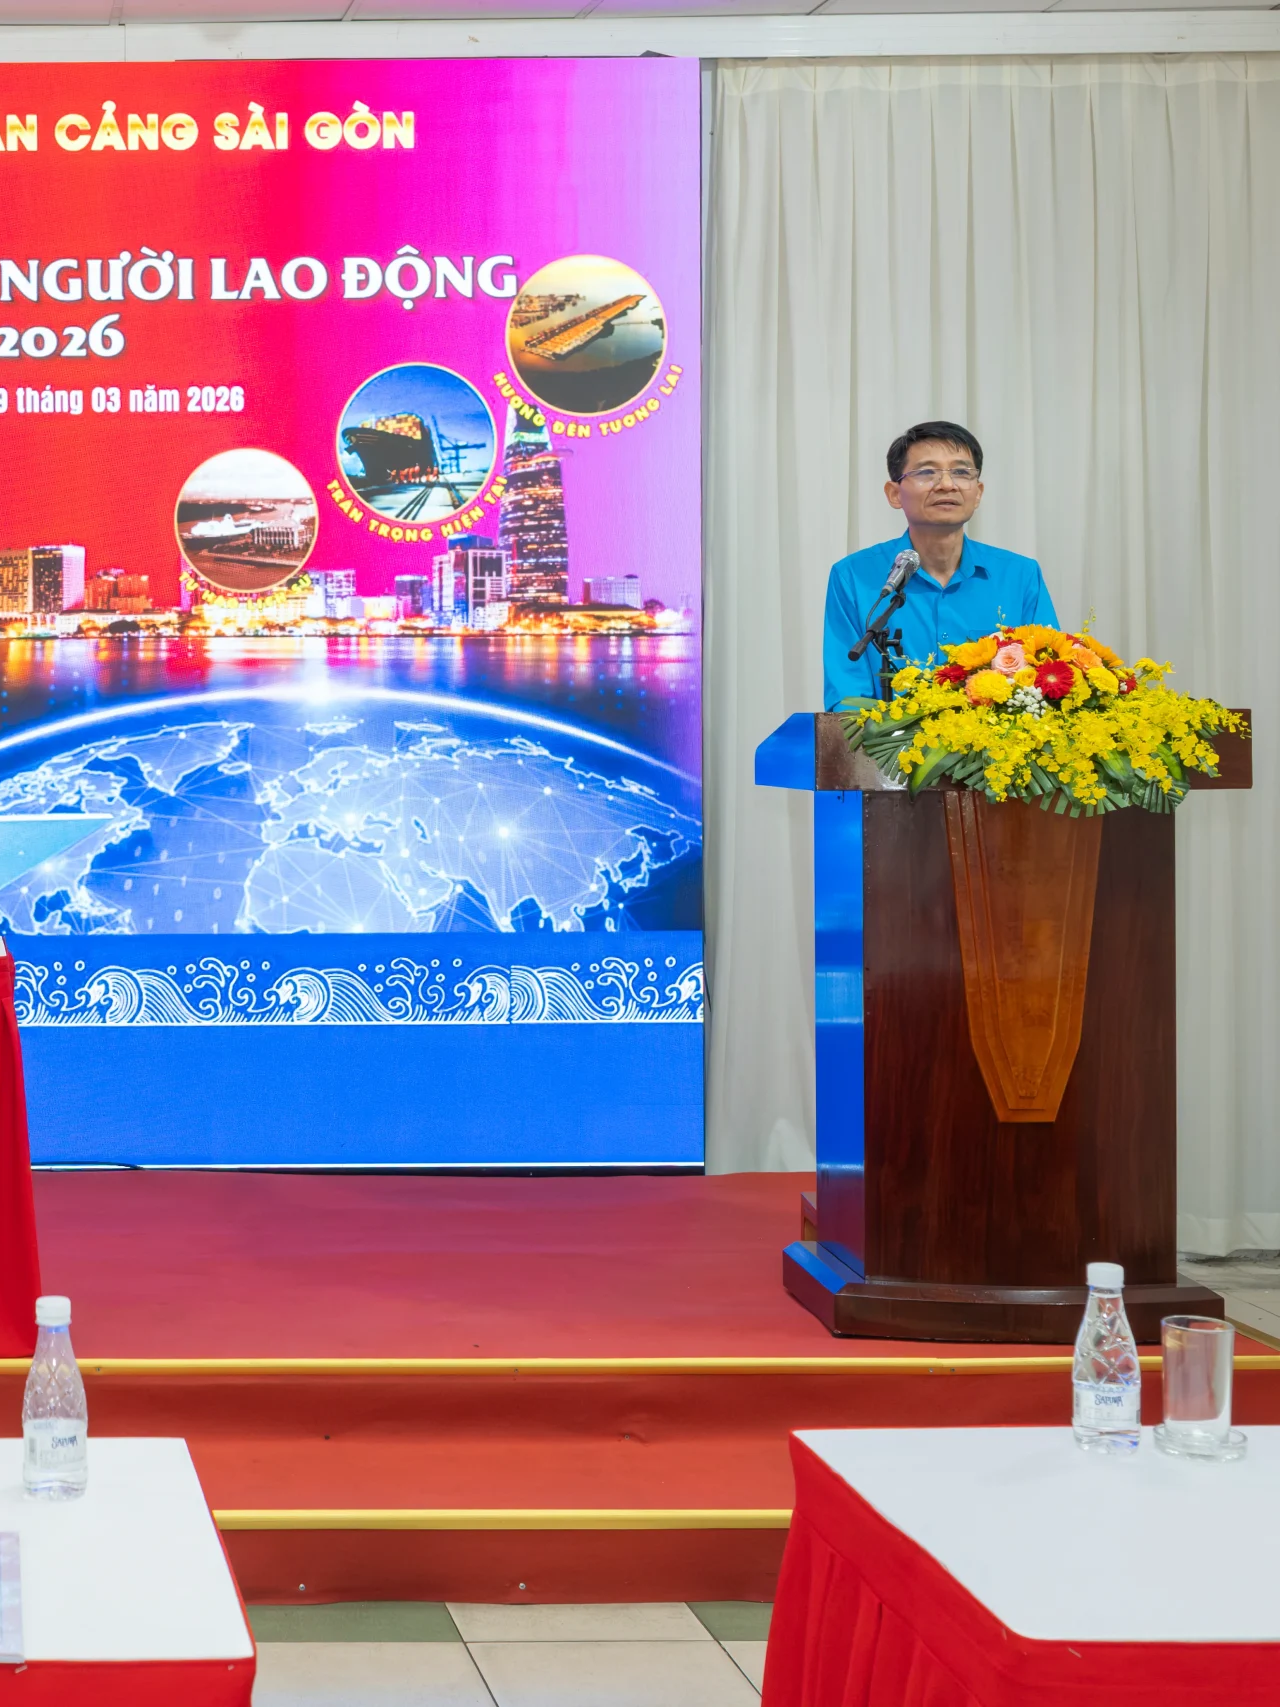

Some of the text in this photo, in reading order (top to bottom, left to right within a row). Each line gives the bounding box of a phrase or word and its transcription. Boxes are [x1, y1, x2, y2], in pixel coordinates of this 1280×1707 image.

[54, 100, 199, 151] CẢNG
[213, 101, 289, 151] SÀI
[304, 100, 416, 151] GÒN
[209, 256, 329, 301] LAO
[341, 243, 519, 311] ĐỘNG
[16, 384, 84, 416] tháng
[91, 386, 121, 413] 03
[129, 384, 180, 413] năm
[187, 385, 245, 413] 2026
[658, 364, 683, 396] LAI
